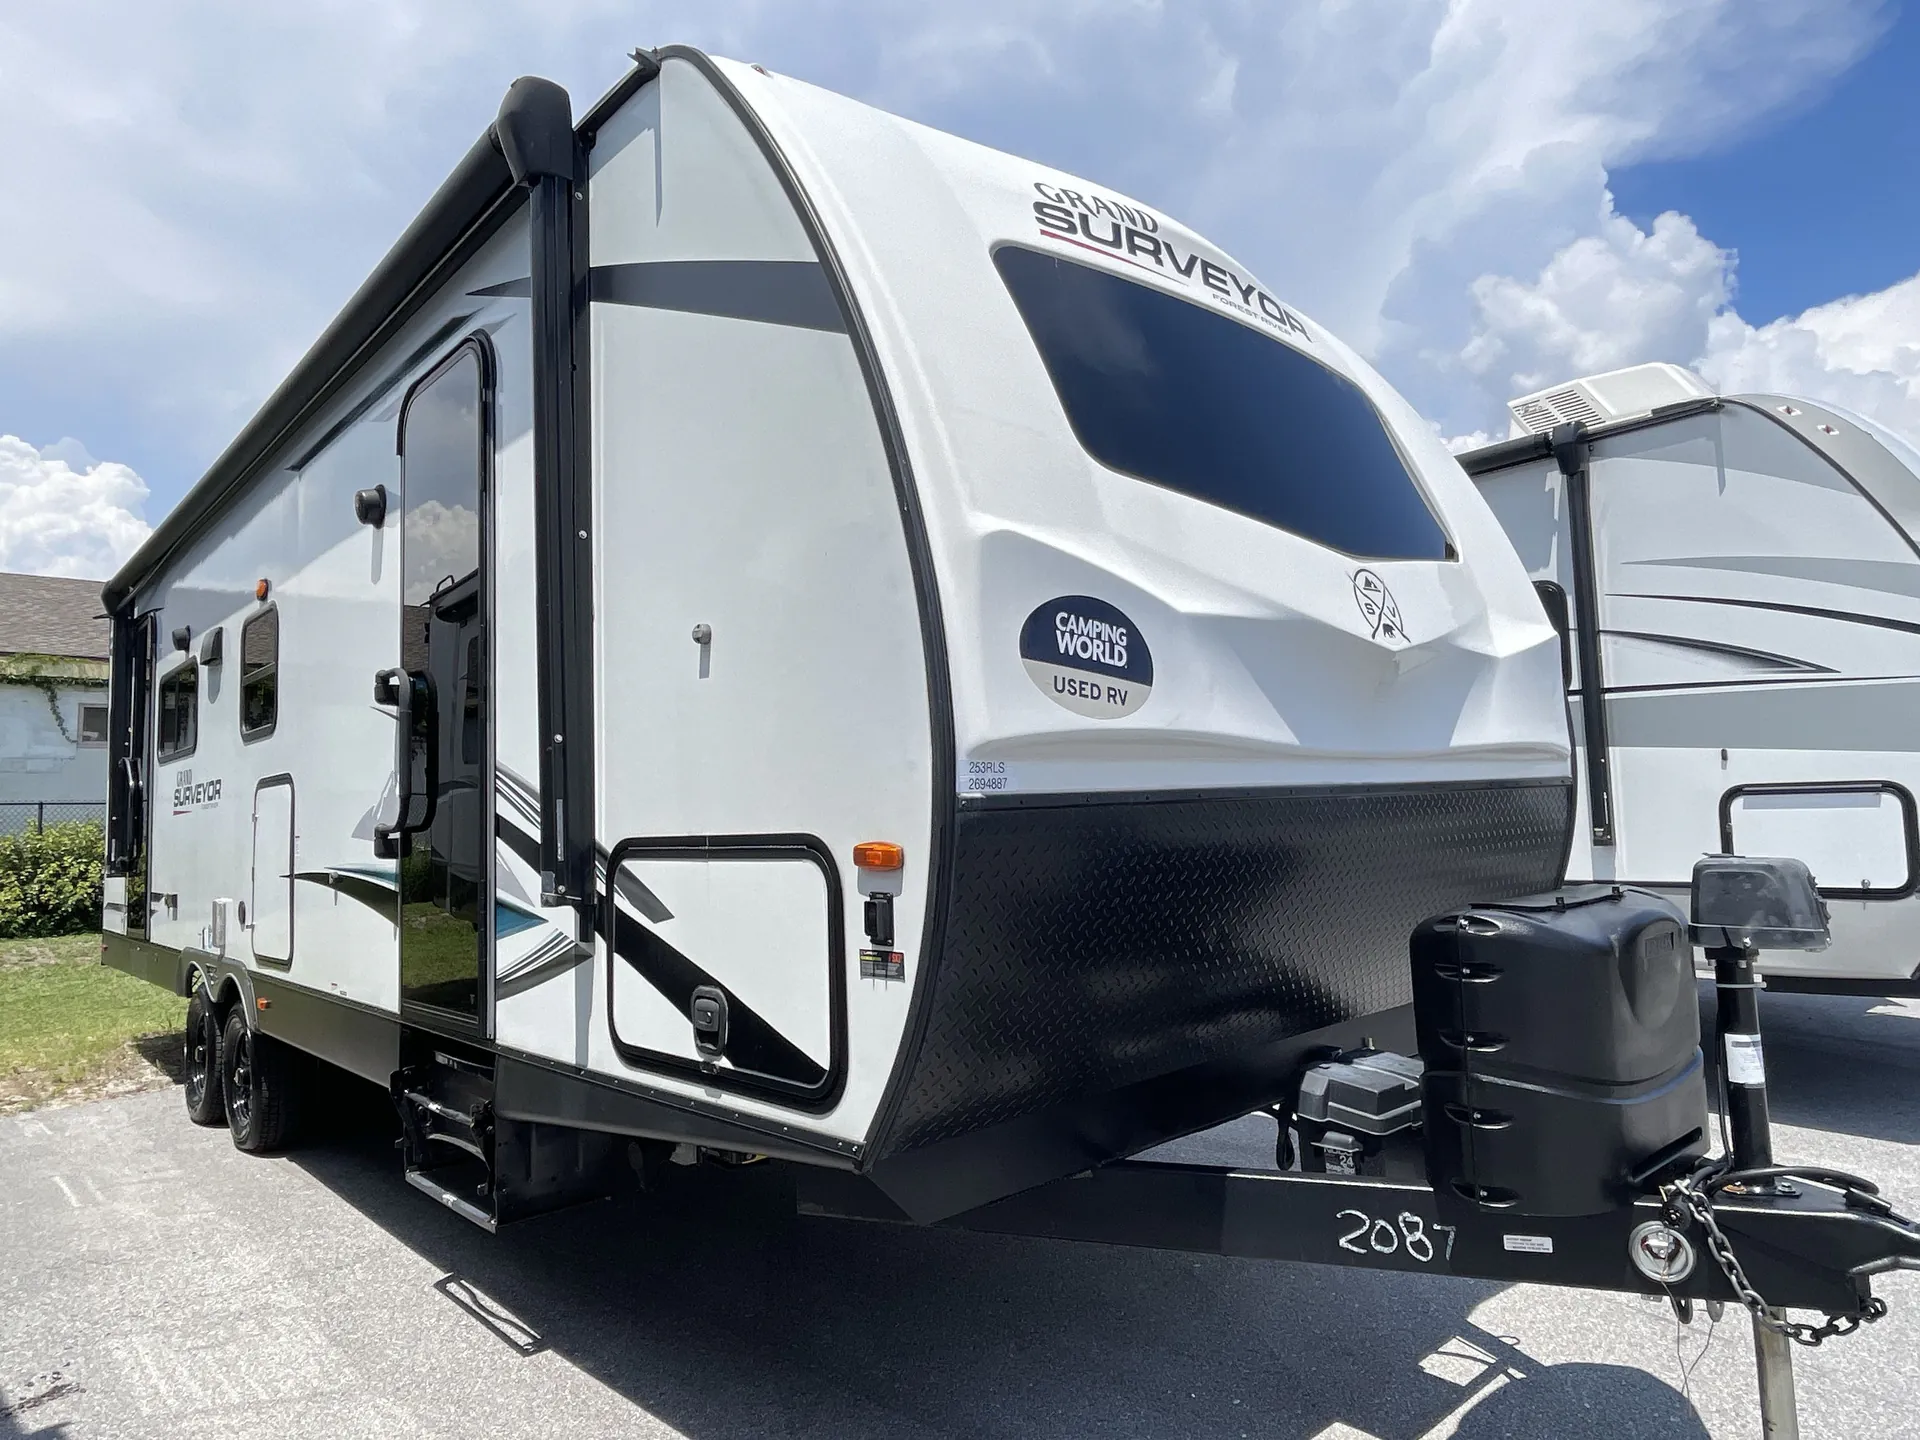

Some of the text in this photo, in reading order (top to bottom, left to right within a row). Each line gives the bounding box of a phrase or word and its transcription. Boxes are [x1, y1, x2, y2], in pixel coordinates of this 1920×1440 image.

[1033, 182, 1159, 234] GRAND
[1032, 201, 1313, 343] SURVEYOR
[1212, 293, 1292, 337] FOREST RIVER
[1055, 611, 1128, 647] CAMPING
[1055, 629, 1128, 668] WORLD
[1053, 675, 1129, 706] USED RV
[968, 761, 1006, 774] 253RLS
[968, 777, 1008, 790] 2694887
[173, 778, 222, 808] SURVEYOR
[1335, 1209, 1457, 1262] 2087
